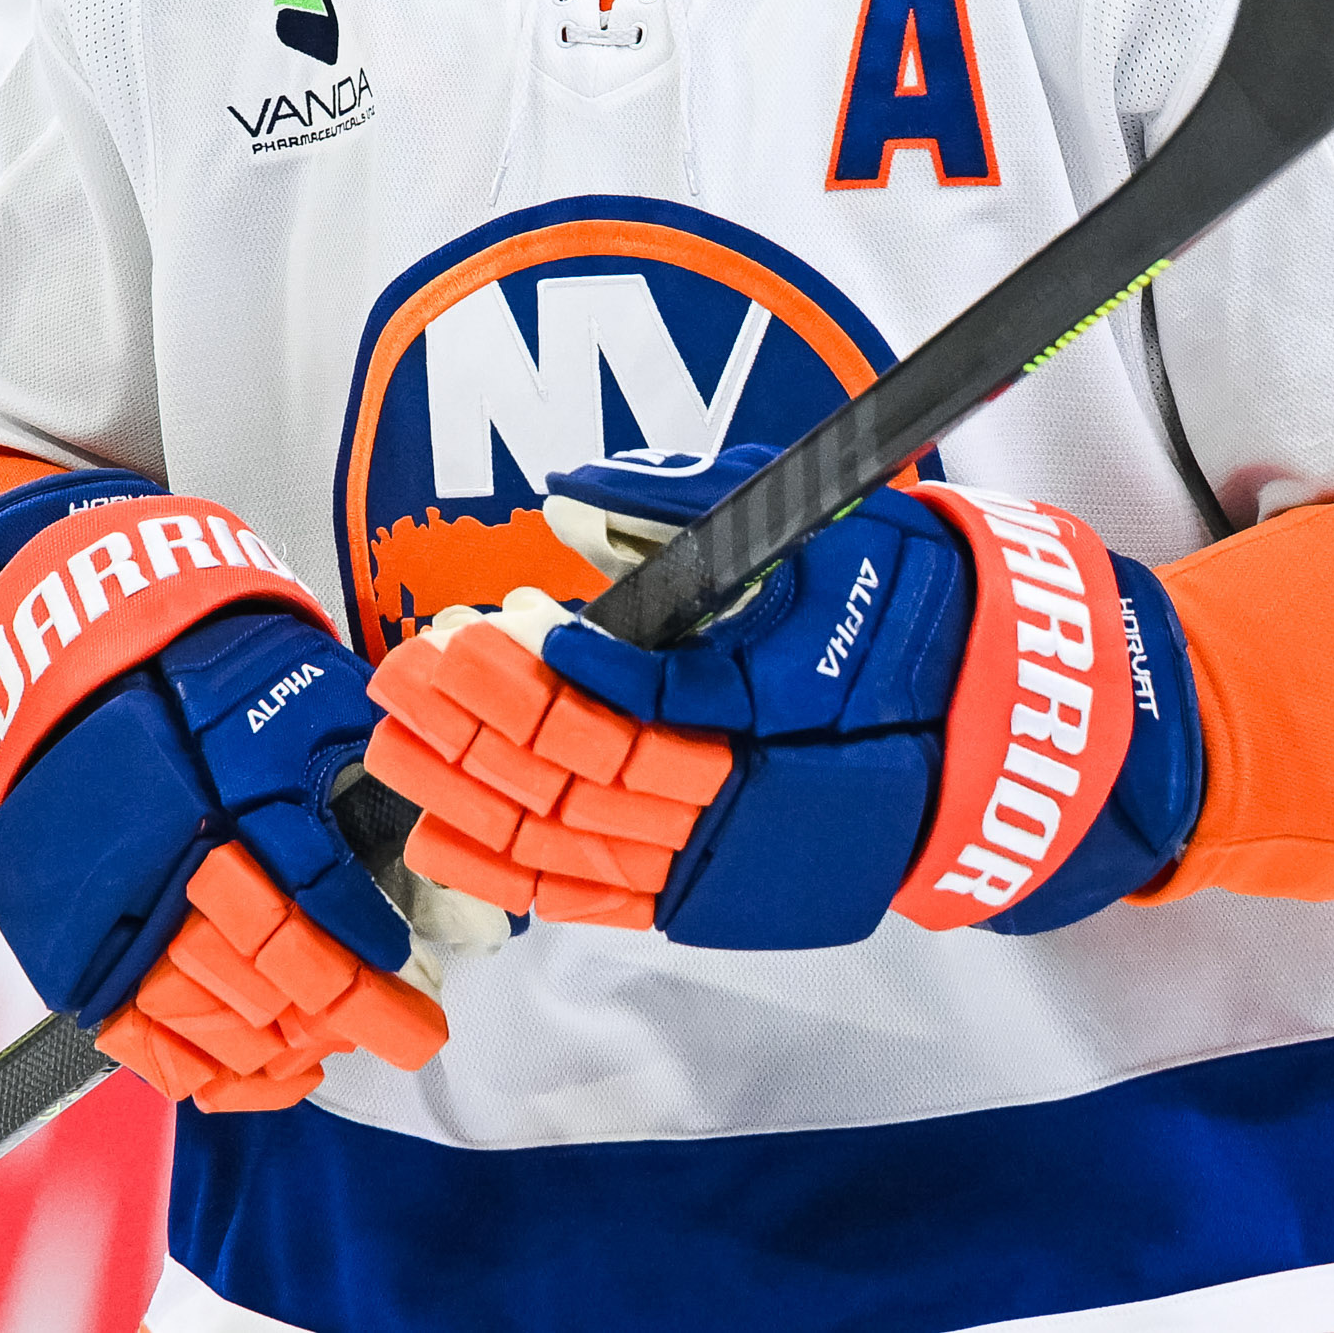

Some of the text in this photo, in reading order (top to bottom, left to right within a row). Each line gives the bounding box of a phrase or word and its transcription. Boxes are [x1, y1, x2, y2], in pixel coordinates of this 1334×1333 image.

[227, 67, 373, 138] VANDA
[252, 112, 366, 155] PHARMACEUTICALS
[424, 273, 772, 499] NY
[816, 557, 882, 680] ALPHA
[1119, 597, 1160, 721] HORVAT
[246, 662, 325, 734] ALPHA
